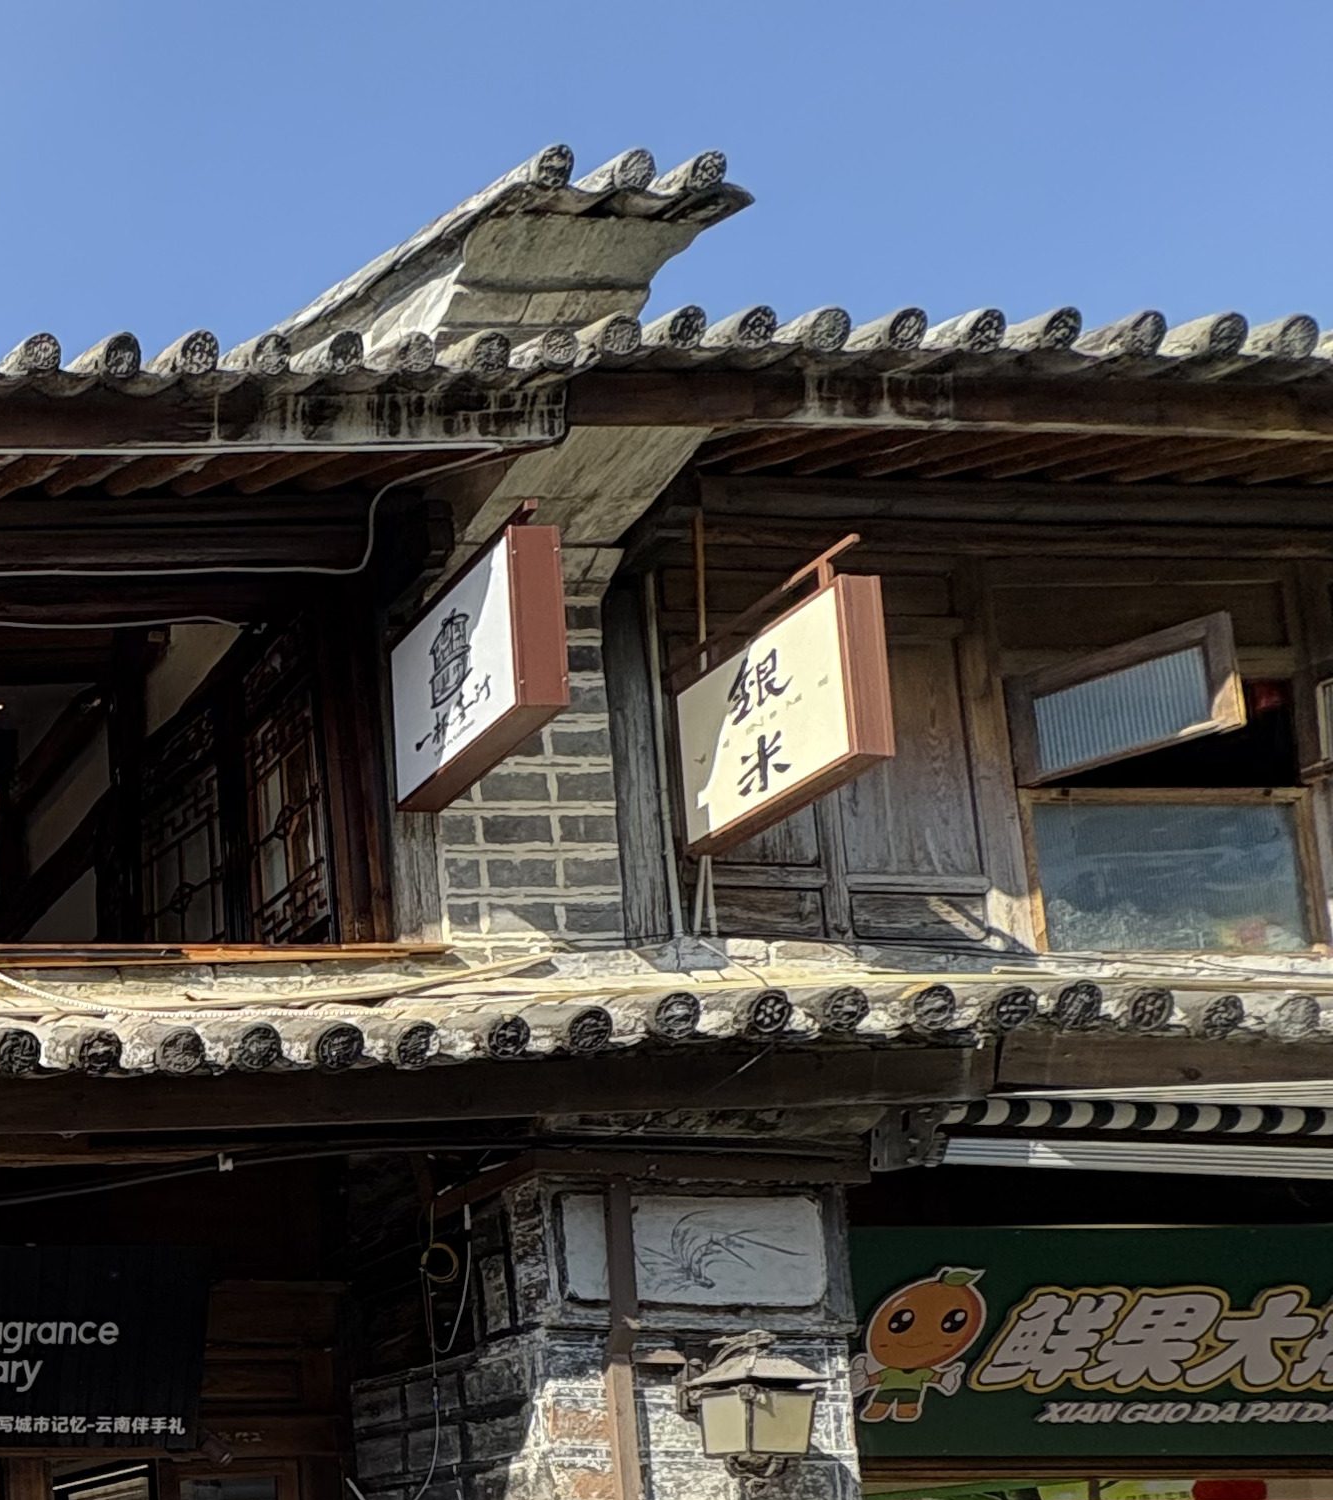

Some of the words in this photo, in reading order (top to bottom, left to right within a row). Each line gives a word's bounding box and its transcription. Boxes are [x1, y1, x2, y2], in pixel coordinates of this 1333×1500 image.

[728, 648, 794, 796] 銀米
[1038, 1402, 1124, 1423] XIAN
[1119, 1402, 1192, 1423] GUO
[1190, 1402, 1241, 1423] DA
[1240, 1402, 1301, 1423] PAI
